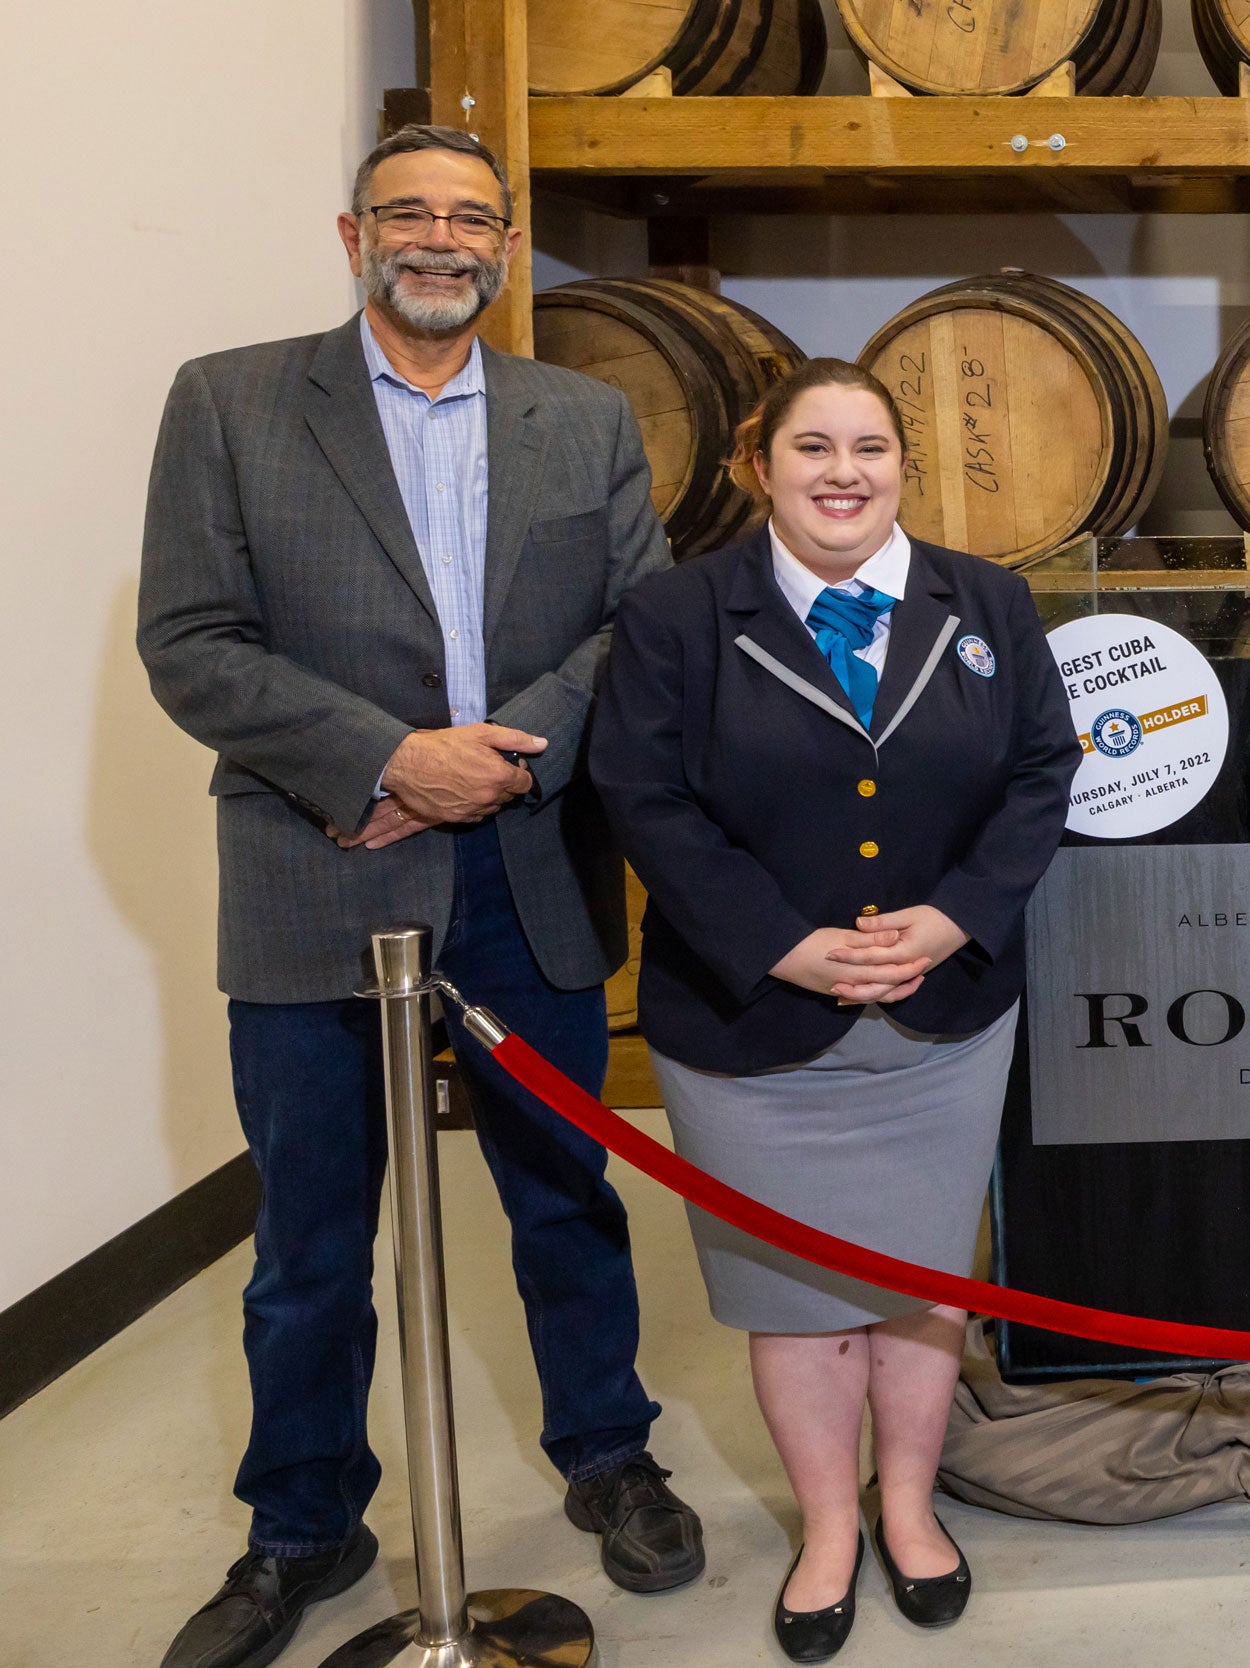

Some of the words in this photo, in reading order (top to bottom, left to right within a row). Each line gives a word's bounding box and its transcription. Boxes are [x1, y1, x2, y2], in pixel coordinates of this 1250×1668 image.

[1060, 651, 1102, 677] GEST
[1108, 635, 1156, 662] CUBA
[1083, 656, 1167, 694] COCKTAIL
[1095, 711, 1130, 731] GUINNESS
[1142, 702, 1202, 729] HOLDER
[1095, 735, 1117, 755] WORLD
[1119, 723, 1139, 755] RECORDS
[1070, 780, 1127, 807] URSDAY,
[1131, 768, 1160, 787] JULY
[1163, 764, 1177, 776] 7,
[1179, 752, 1211, 771] 2022
[1088, 794, 1134, 816] CALGARY
[1145, 777, 1189, 798] ALBERTA
